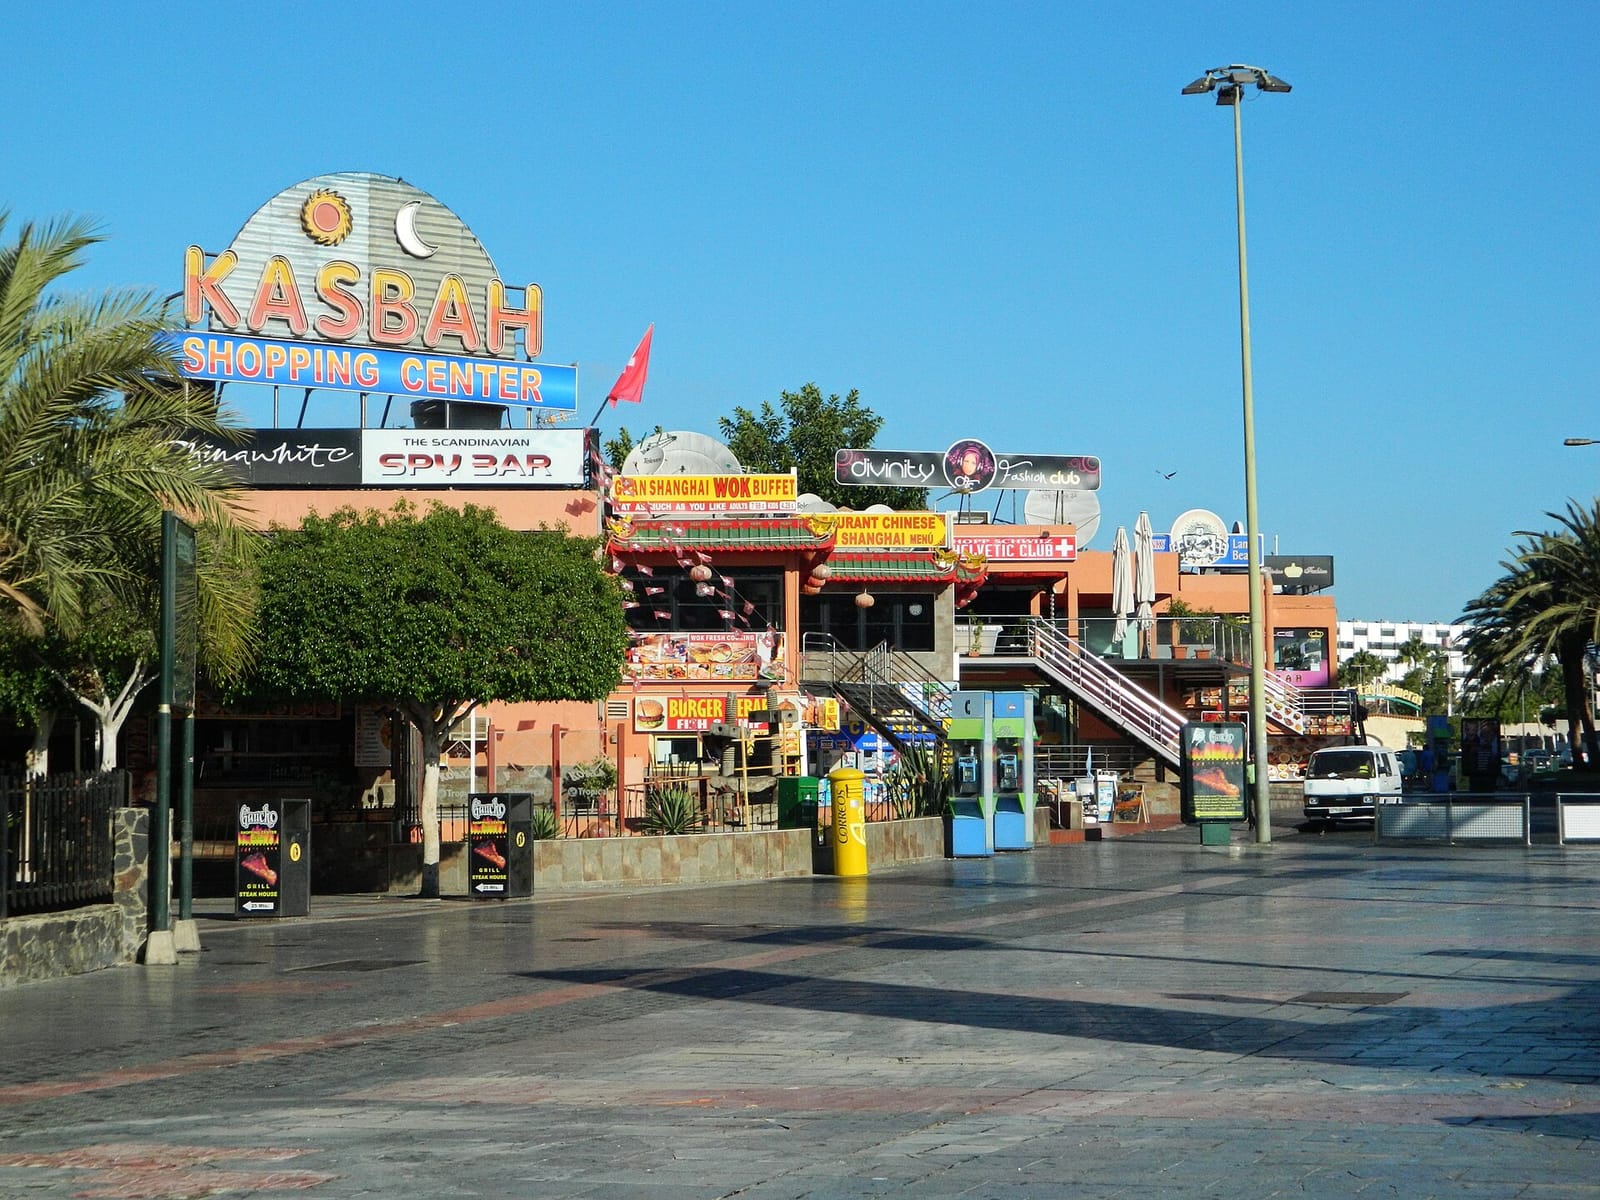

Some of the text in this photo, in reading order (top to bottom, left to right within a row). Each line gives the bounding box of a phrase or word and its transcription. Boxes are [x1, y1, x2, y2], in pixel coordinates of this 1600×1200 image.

[184, 245, 543, 357] KASBAH
[182, 337, 543, 402] SHOPPING CENTER
[403, 438, 530, 447] THE SCANDINAVIAN
[379, 453, 552, 476] SPY BAR
[851, 459, 934, 482] divinity
[999, 459, 1047, 484] Fashion
[1050, 470, 1081, 485] club
[614, 477, 795, 498] GAN SHANGHAI WOK BUFFET
[675, 502, 686, 511] AS
[689, 502, 705, 511] YOU
[709, 502, 727, 511] LIKE
[882, 516, 936, 529] CHINESE
[841, 532, 905, 546] SHANGHAI
[1232, 539, 1249, 549] Lan
[953, 544, 1054, 558] HELVETIC CLUB
[1232, 551, 1249, 561] Bea
[669, 698, 723, 718] BURGER
[240, 803, 278, 829] Gaucho
[472, 797, 506, 819] Gaucho
[837, 789, 848, 844] CORREOS
